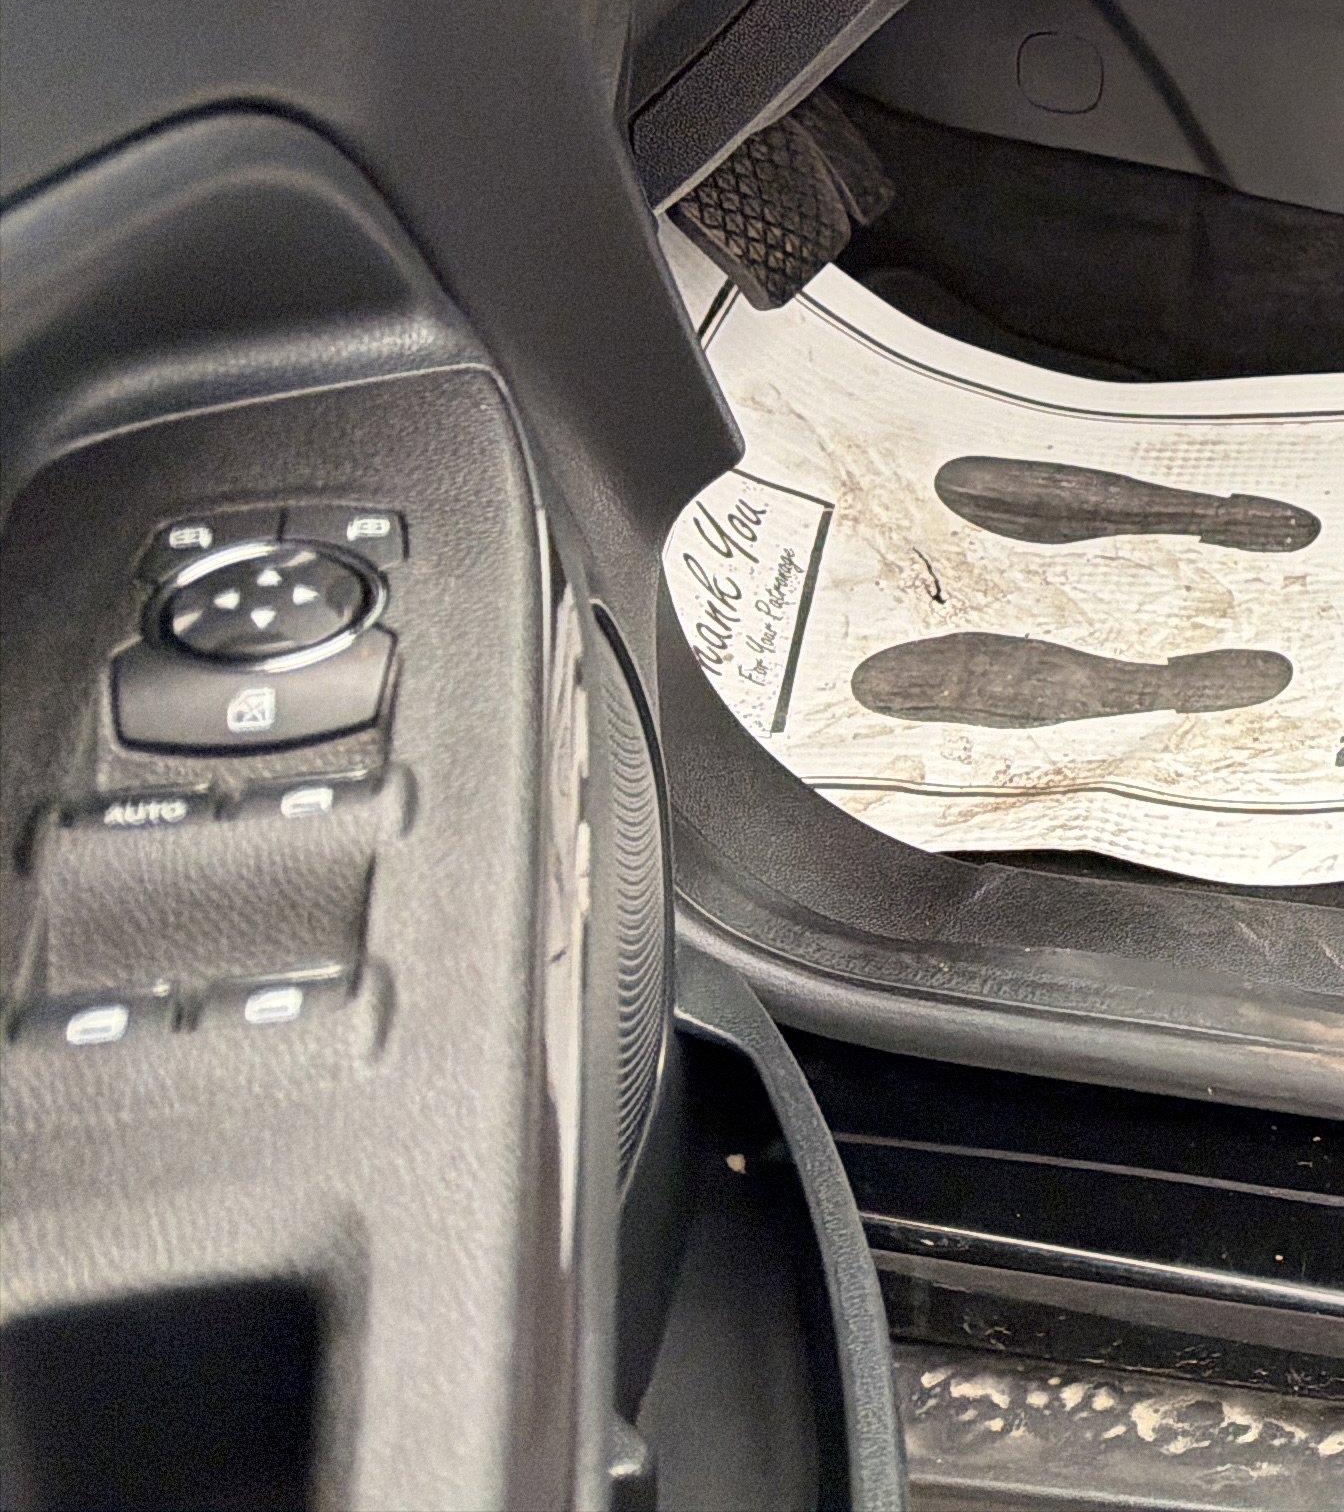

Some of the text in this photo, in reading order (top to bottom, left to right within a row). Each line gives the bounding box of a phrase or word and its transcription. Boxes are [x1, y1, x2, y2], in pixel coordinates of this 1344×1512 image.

[693, 497, 767, 564] You
[737, 548, 804, 686] For Your Patronage
[103, 799, 187, 825] AUTO
